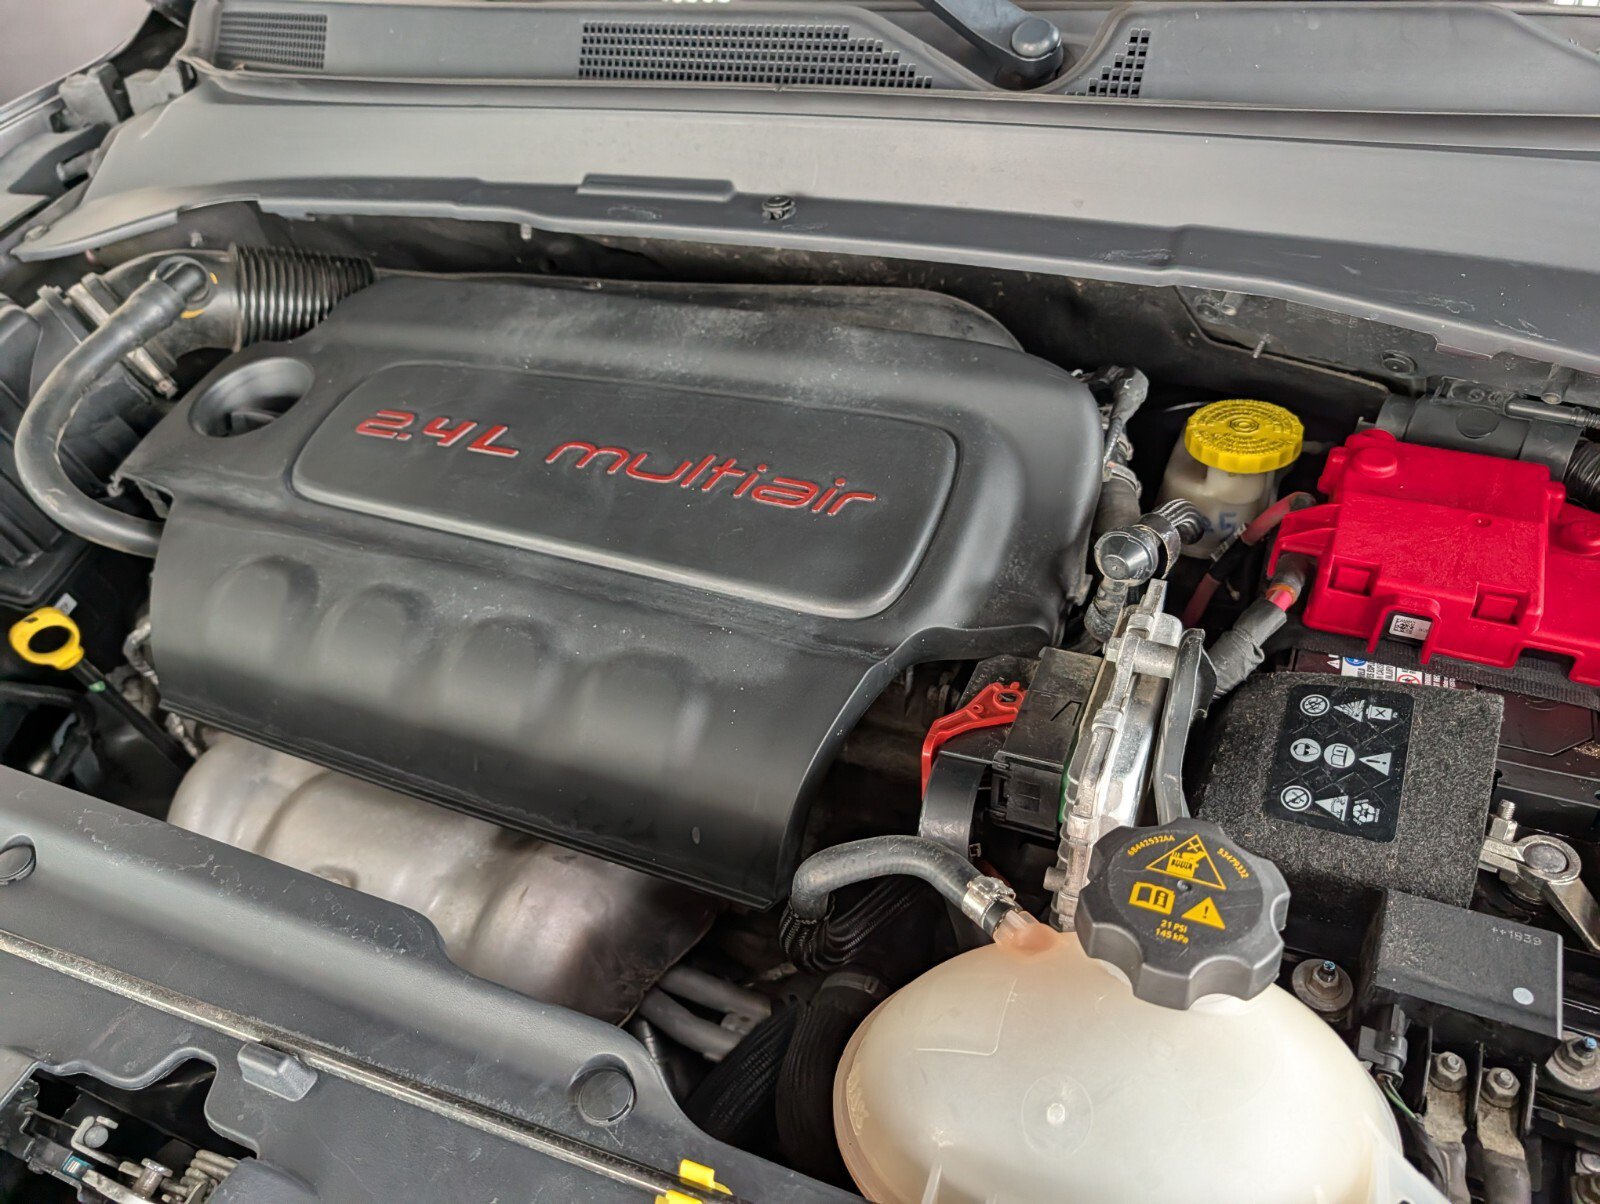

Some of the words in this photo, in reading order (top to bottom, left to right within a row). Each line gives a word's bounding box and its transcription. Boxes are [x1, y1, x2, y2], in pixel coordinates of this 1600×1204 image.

[355, 408, 519, 458] 2.4L
[545, 441, 877, 517] multiair
[1127, 834, 1176, 857] 68442532AA
[1155, 927, 1172, 939] 145
[1172, 932, 1190, 944] kPa
[1160, 919, 1172, 929] 21
[1173, 922, 1188, 934] PSI
